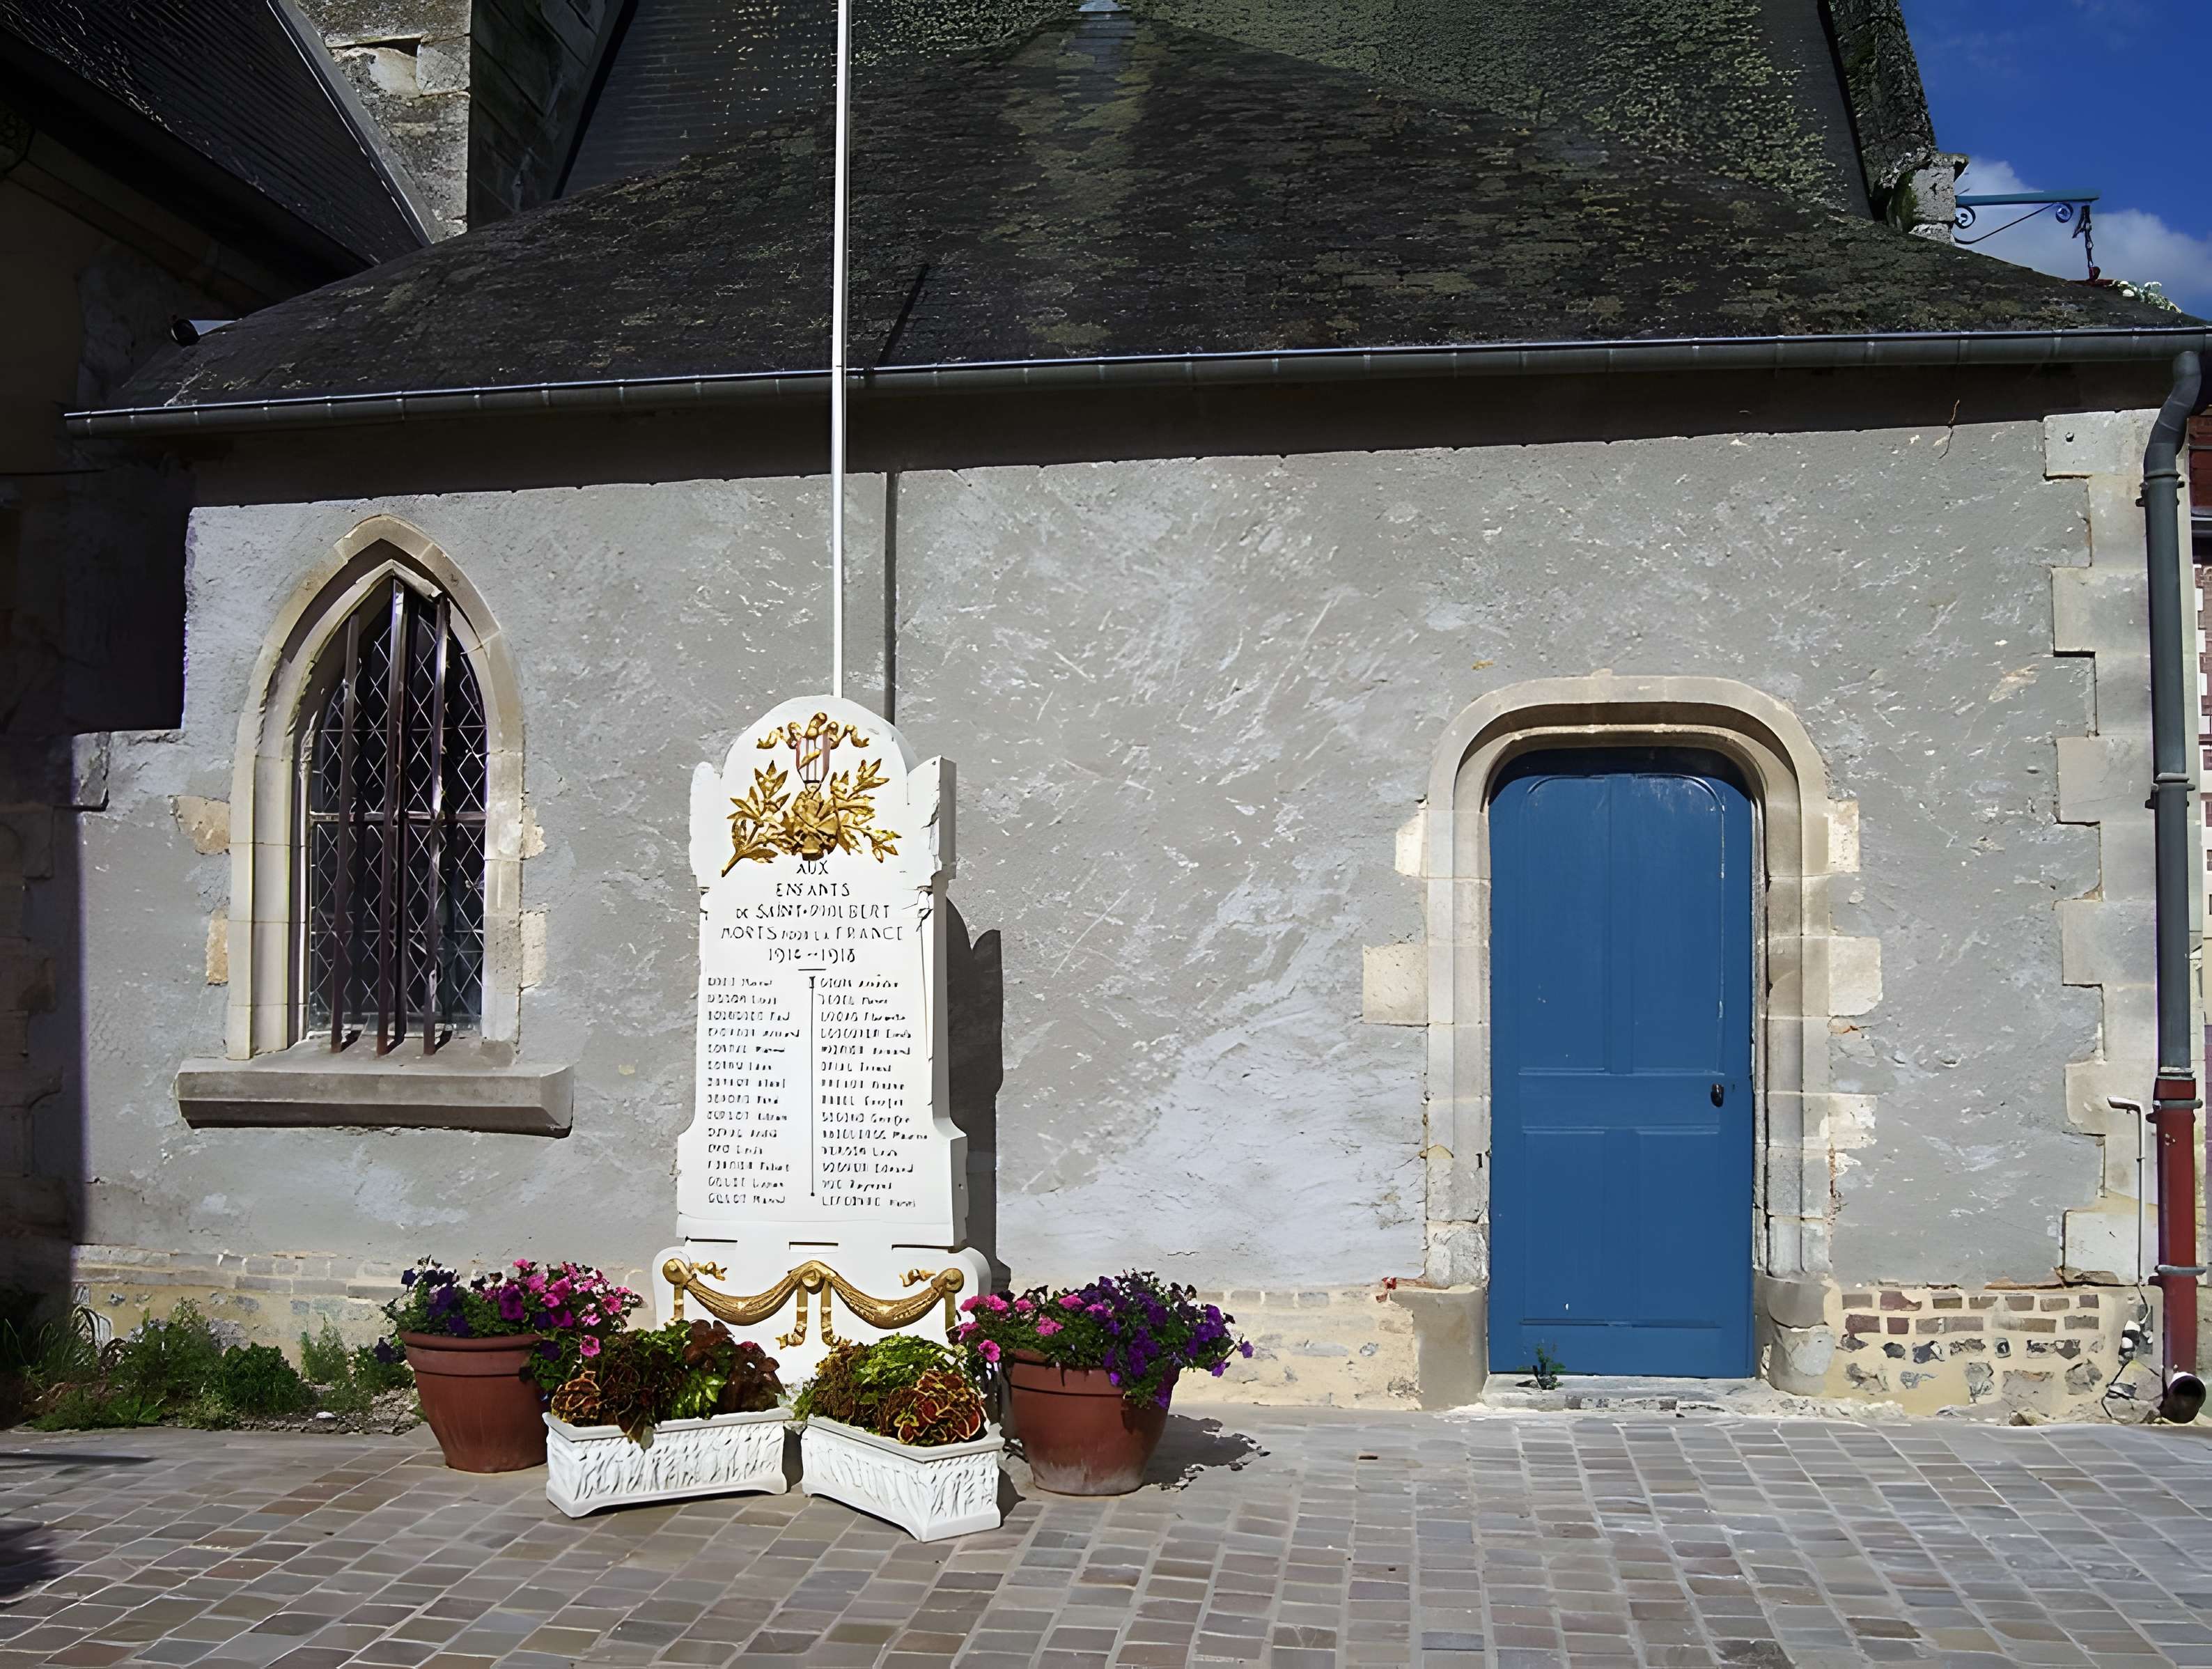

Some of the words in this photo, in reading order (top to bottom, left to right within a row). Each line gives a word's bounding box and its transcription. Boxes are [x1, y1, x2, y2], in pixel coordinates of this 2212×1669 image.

[796, 860, 829, 875] AUX
[776, 883, 850, 896] ENFANTS
[721, 926, 777, 940] MORTS
[836, 926, 903, 940] FRANCE
